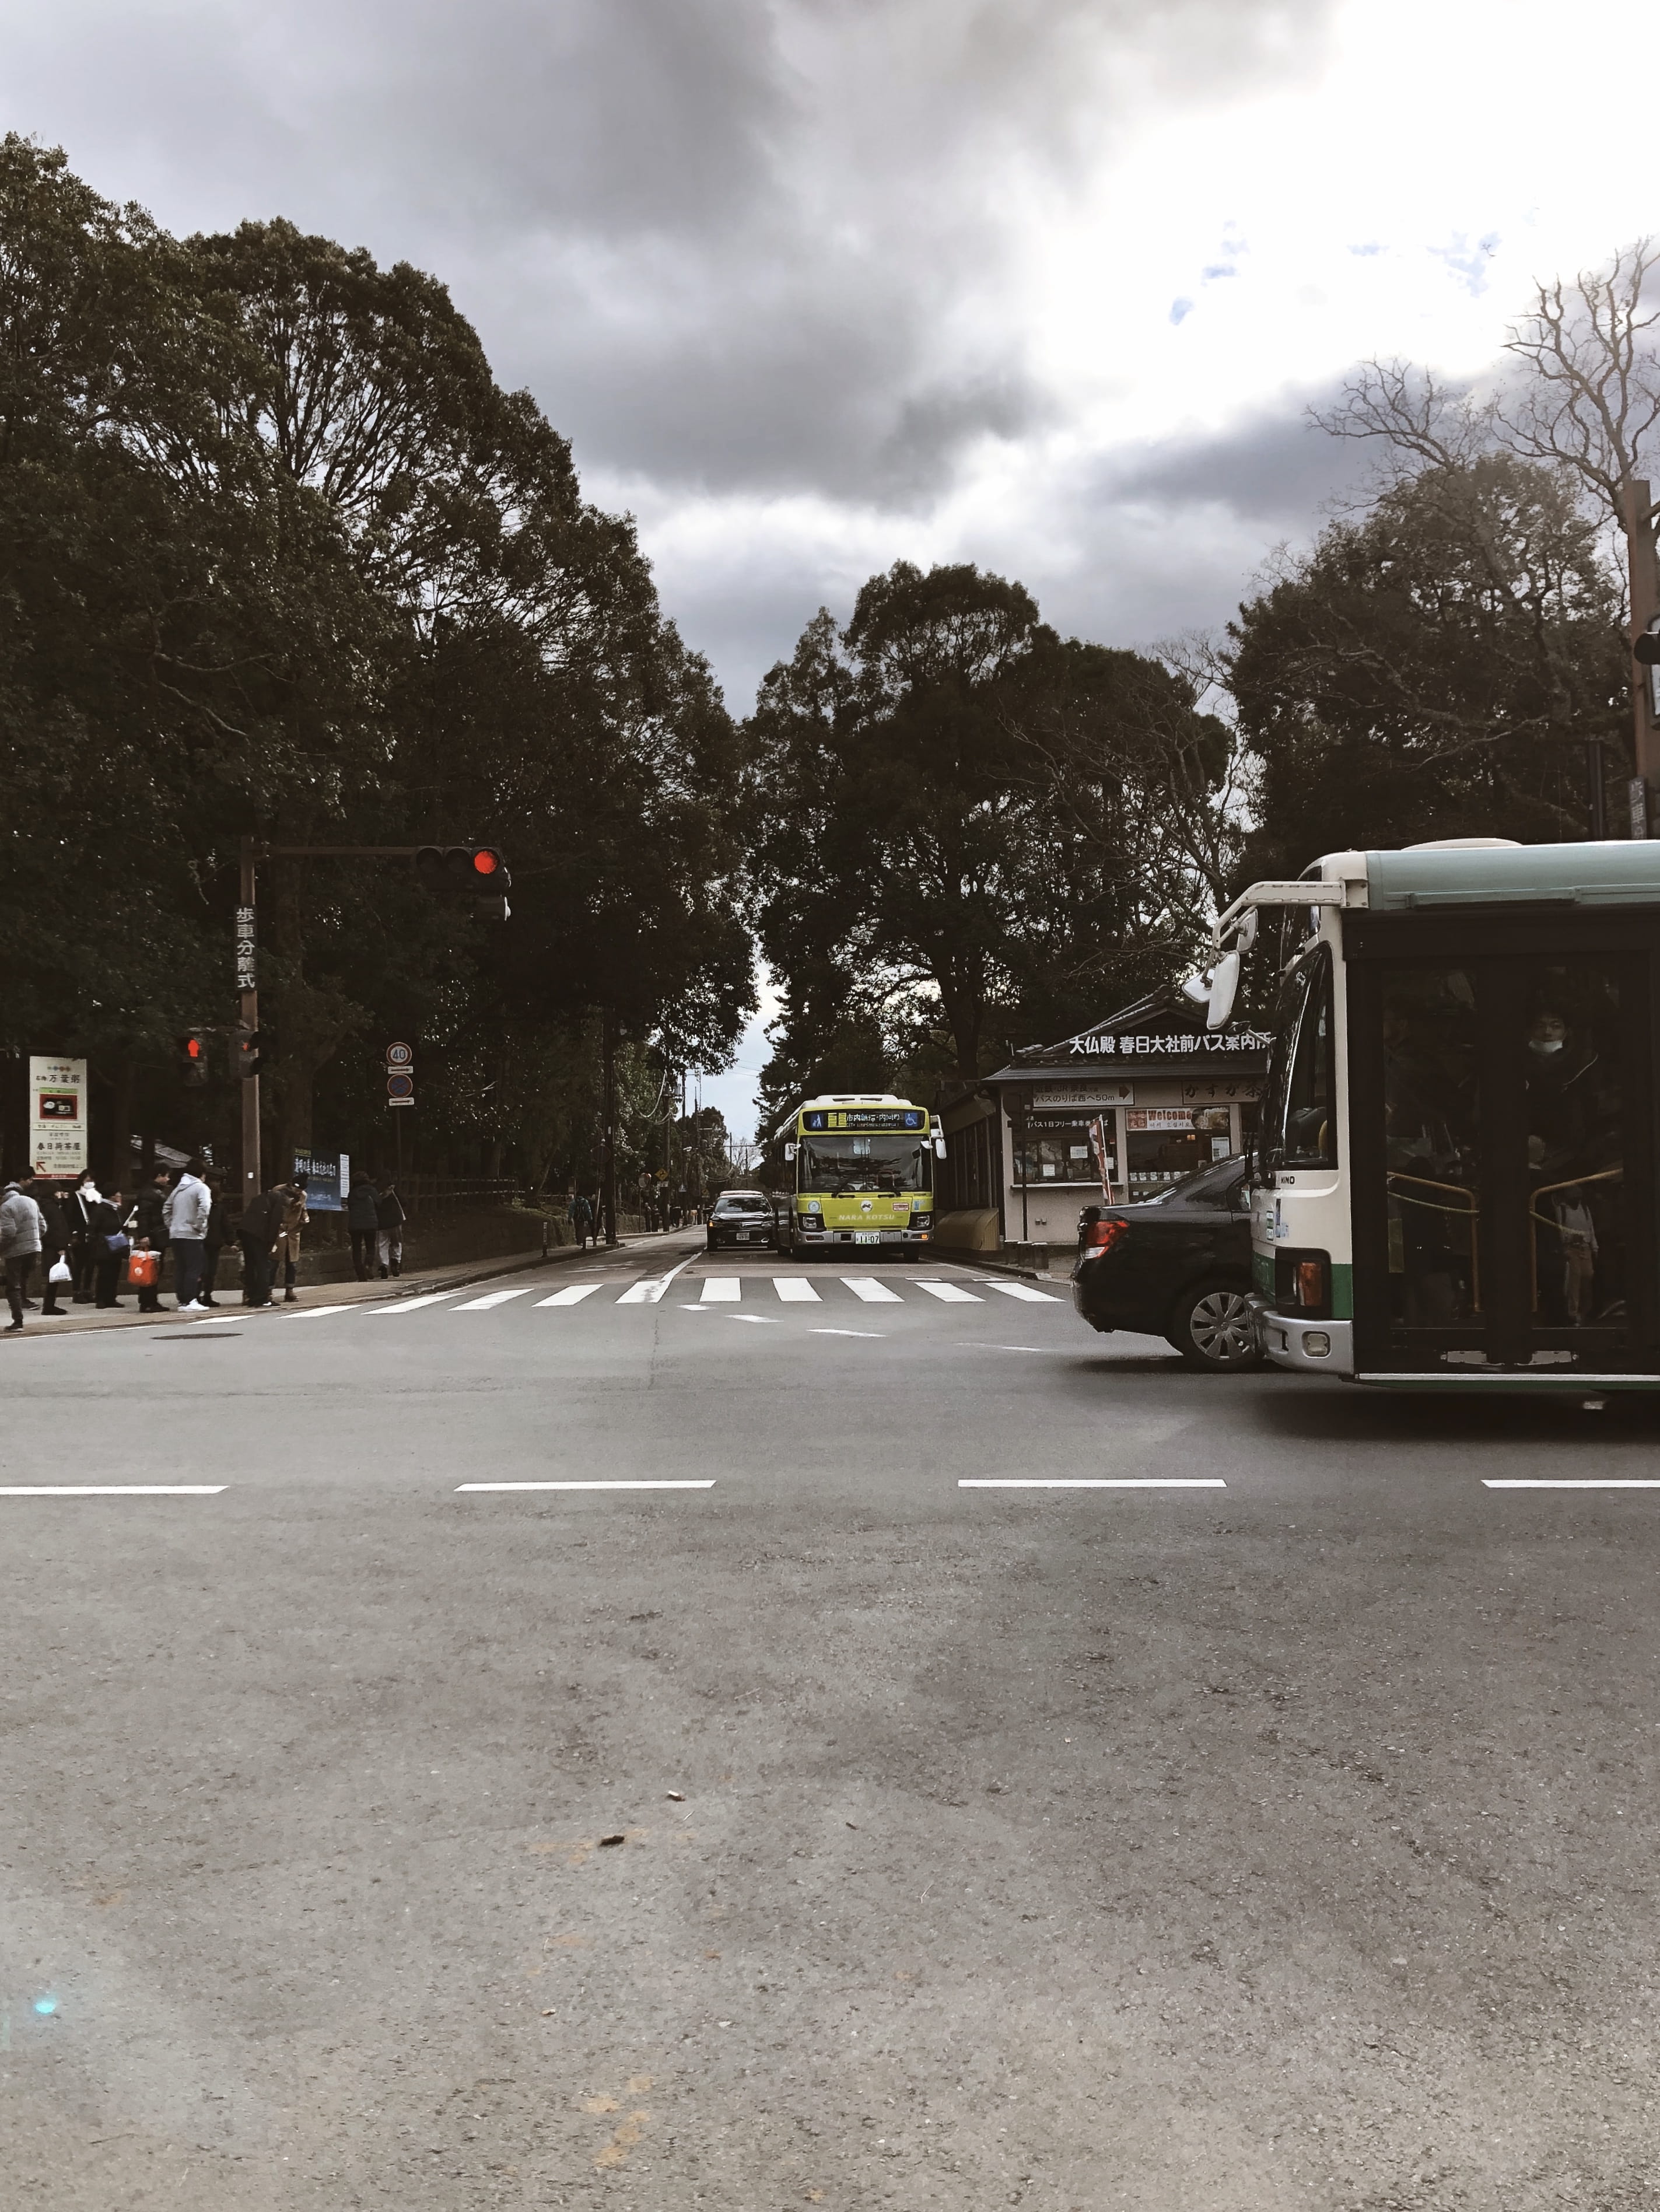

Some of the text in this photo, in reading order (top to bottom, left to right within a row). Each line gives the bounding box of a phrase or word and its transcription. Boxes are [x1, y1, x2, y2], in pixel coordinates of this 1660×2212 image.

[236, 907, 255, 988] 歩車分離式
[1069, 1031, 1271, 1054] 大仏殿 春日大社前バス案内所
[393, 1049, 406, 1059] 40
[1148, 1110, 1192, 1121] Welcome
[1281, 1176, 1295, 1184] HINO
